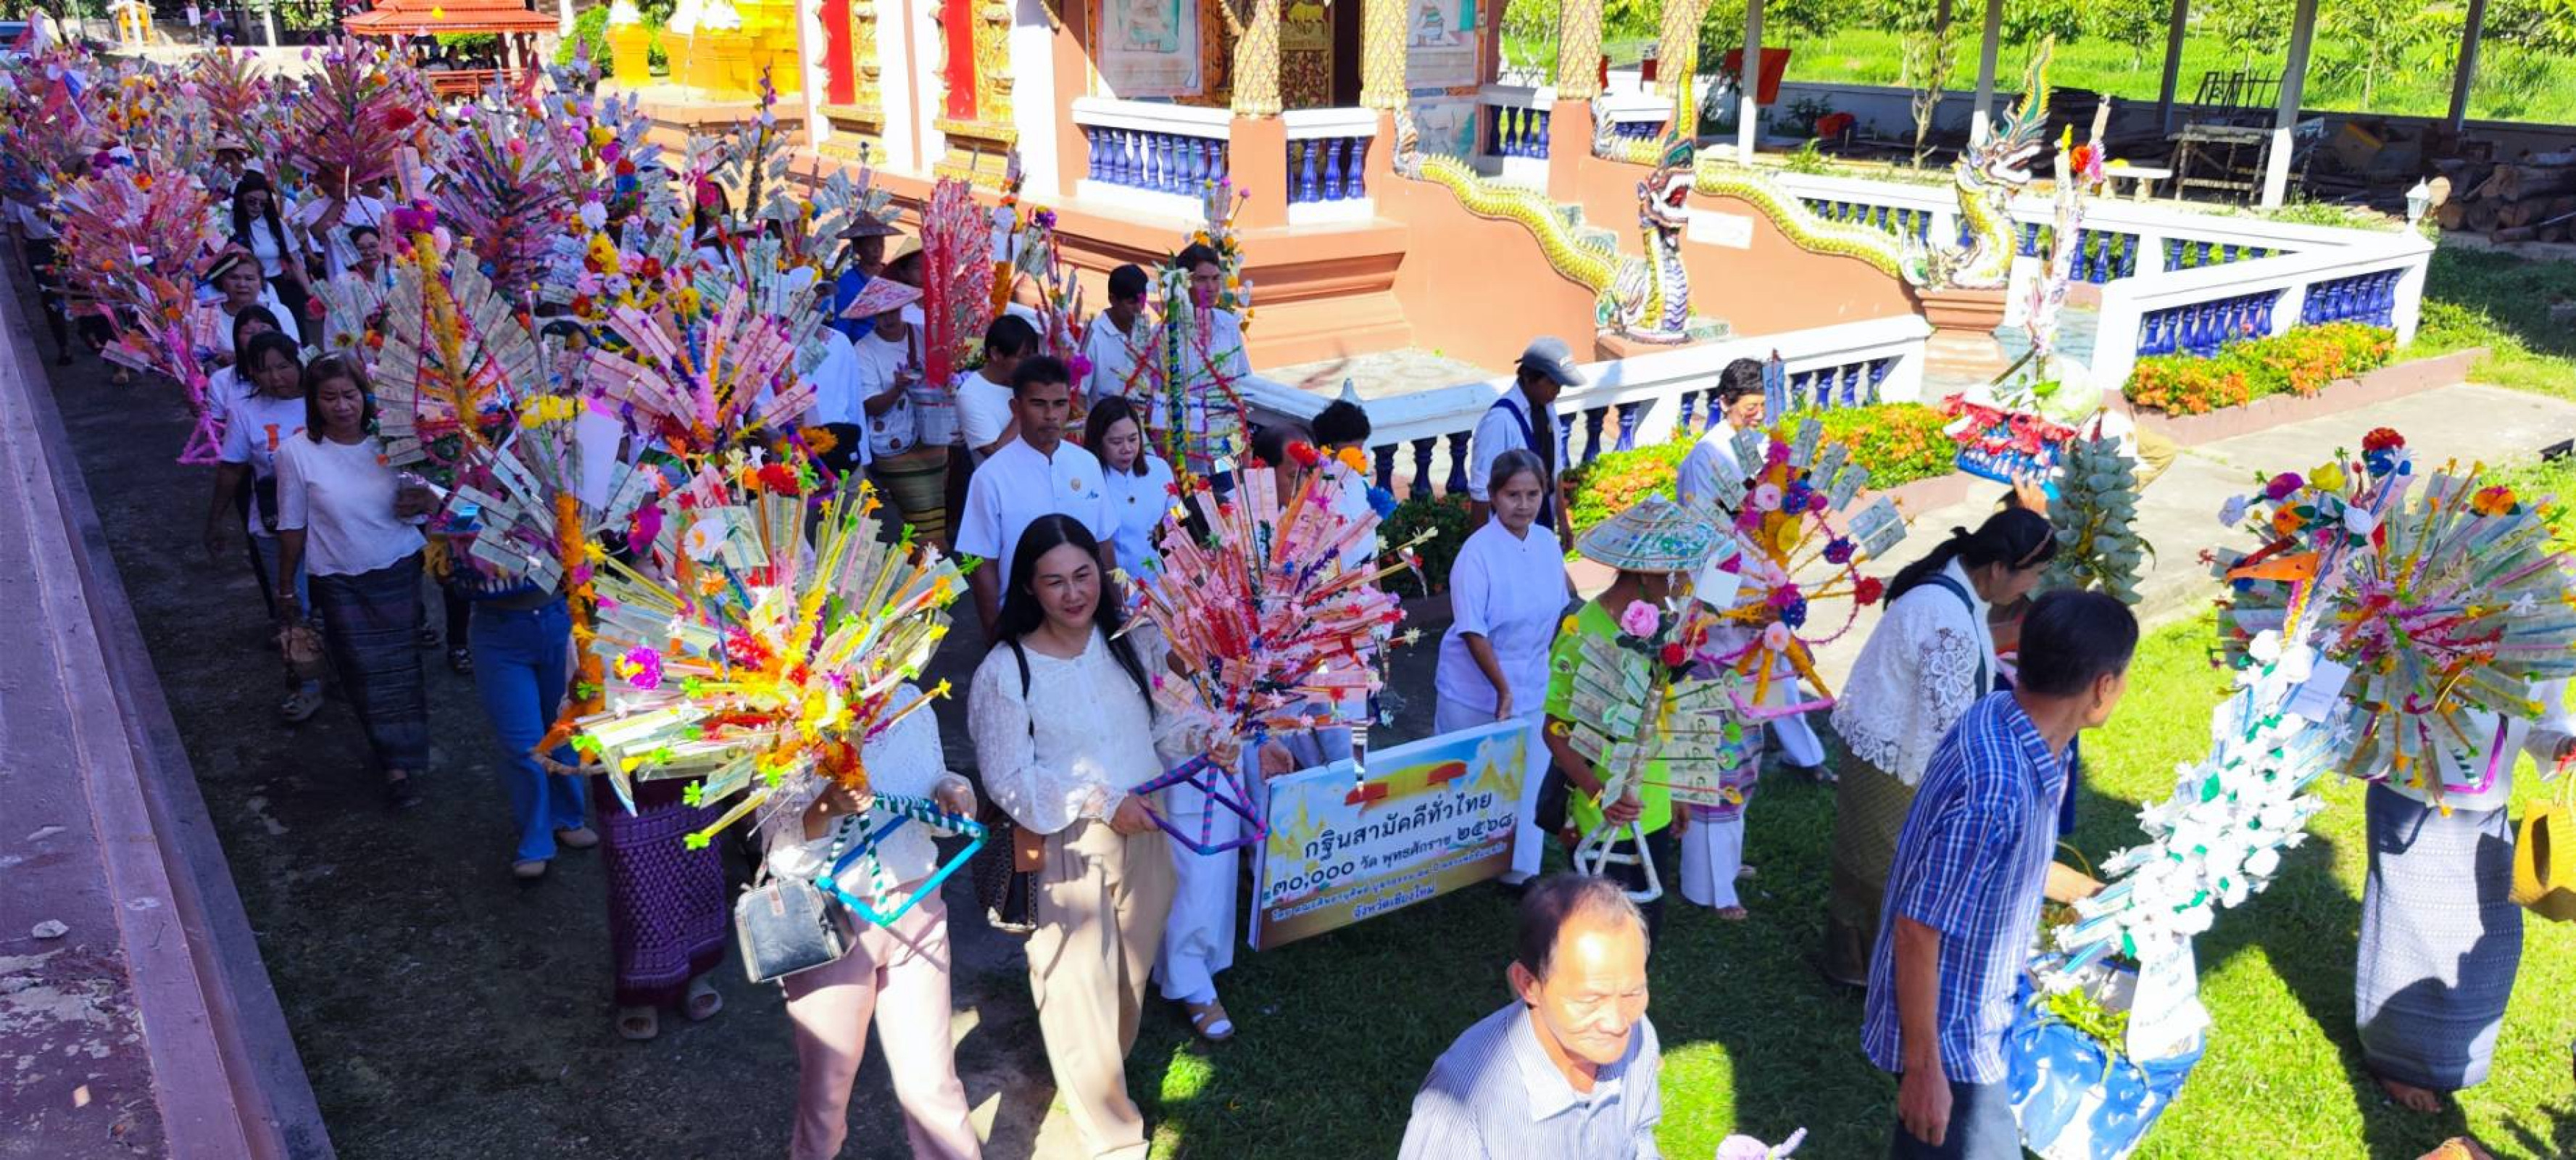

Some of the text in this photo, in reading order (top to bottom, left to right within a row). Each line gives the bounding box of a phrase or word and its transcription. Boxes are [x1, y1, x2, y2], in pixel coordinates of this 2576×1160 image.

[1305, 792, 1492, 861] กฐินสามัคคีทั่วไทย
[1457, 812, 1513, 841] ๒๕๖๘
